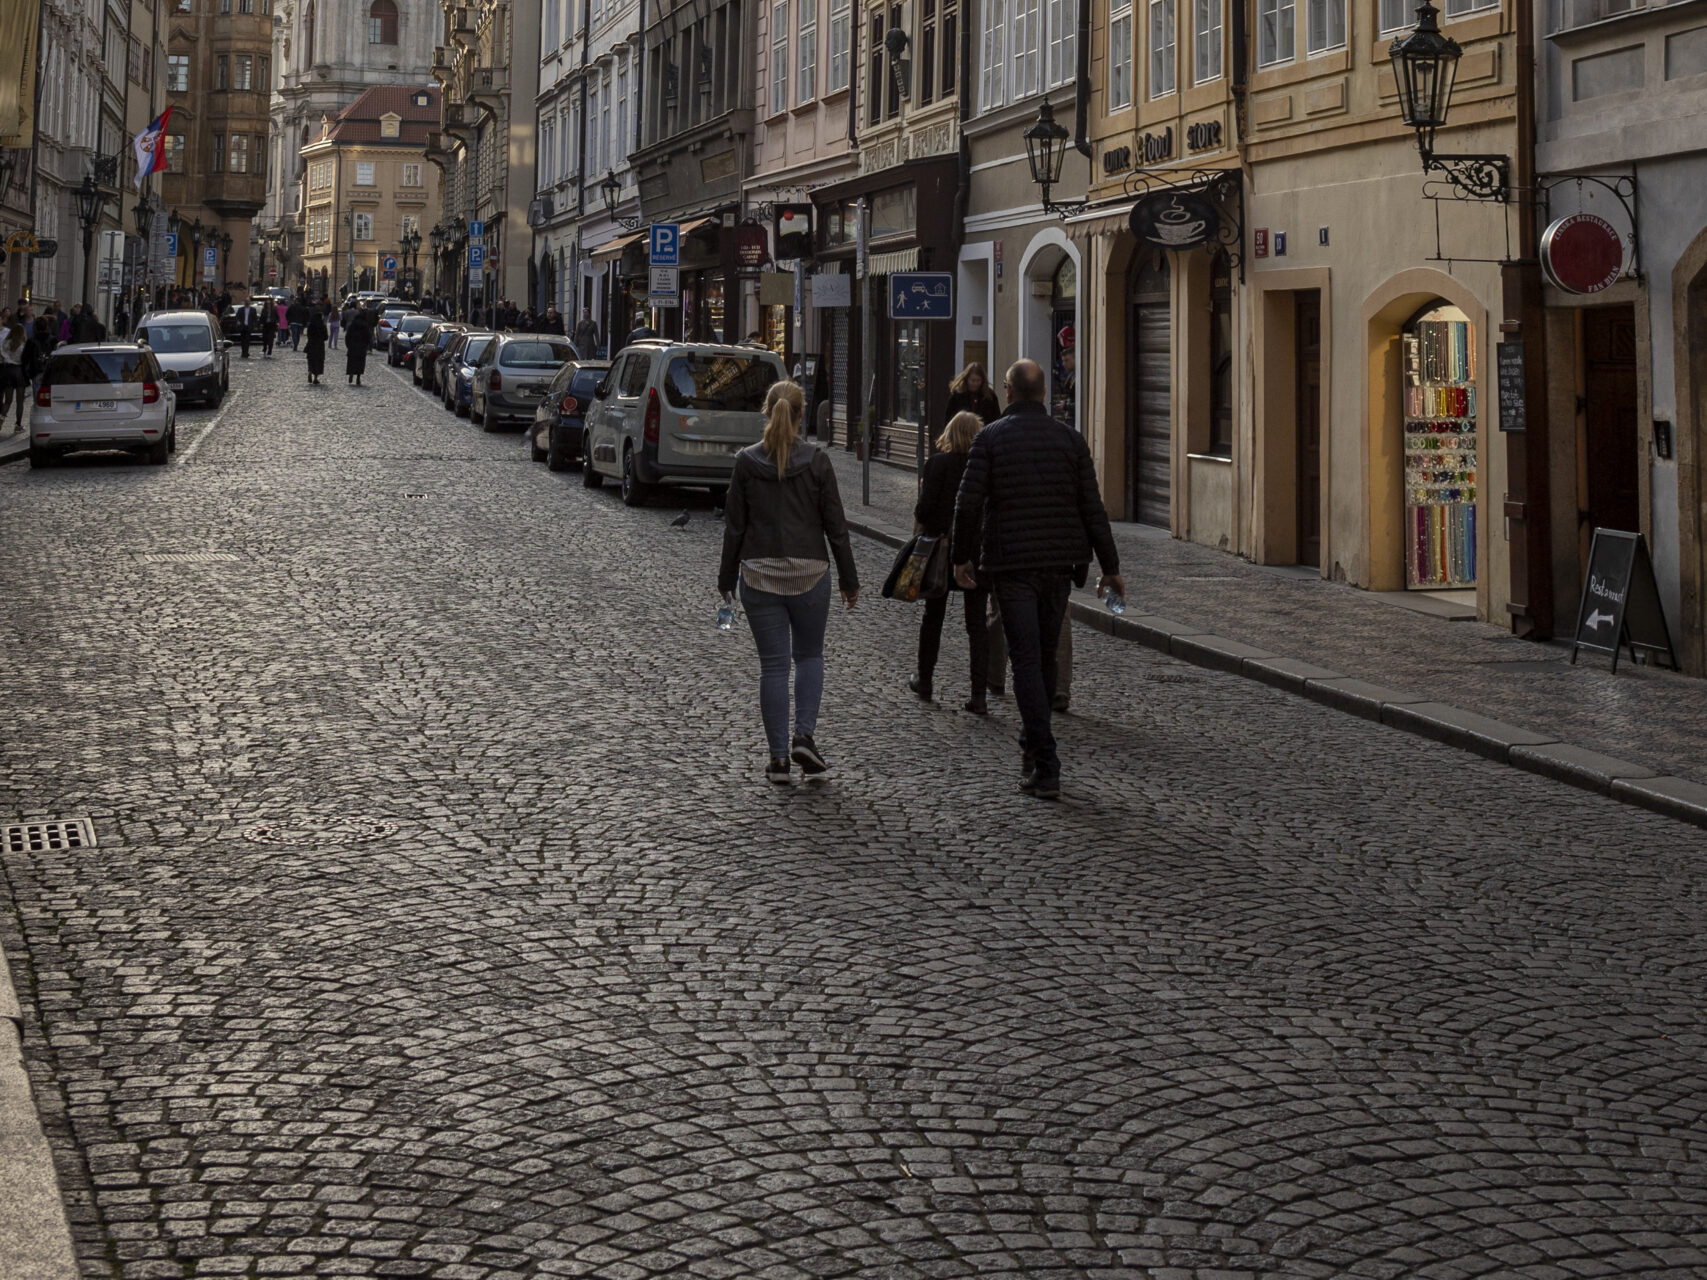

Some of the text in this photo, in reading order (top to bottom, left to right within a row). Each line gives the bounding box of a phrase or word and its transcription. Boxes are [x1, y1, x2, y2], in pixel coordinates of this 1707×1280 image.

[1103, 146, 1131, 173] wine
[1144, 126, 1172, 162] food
[1187, 120, 1221, 150] store
[1576, 215, 1618, 240] RESTAURACE
[656, 228, 673, 253] P
[206, 250, 214, 260] P
[472, 248, 480, 261] P
[1588, 282, 1605, 293] FAN
